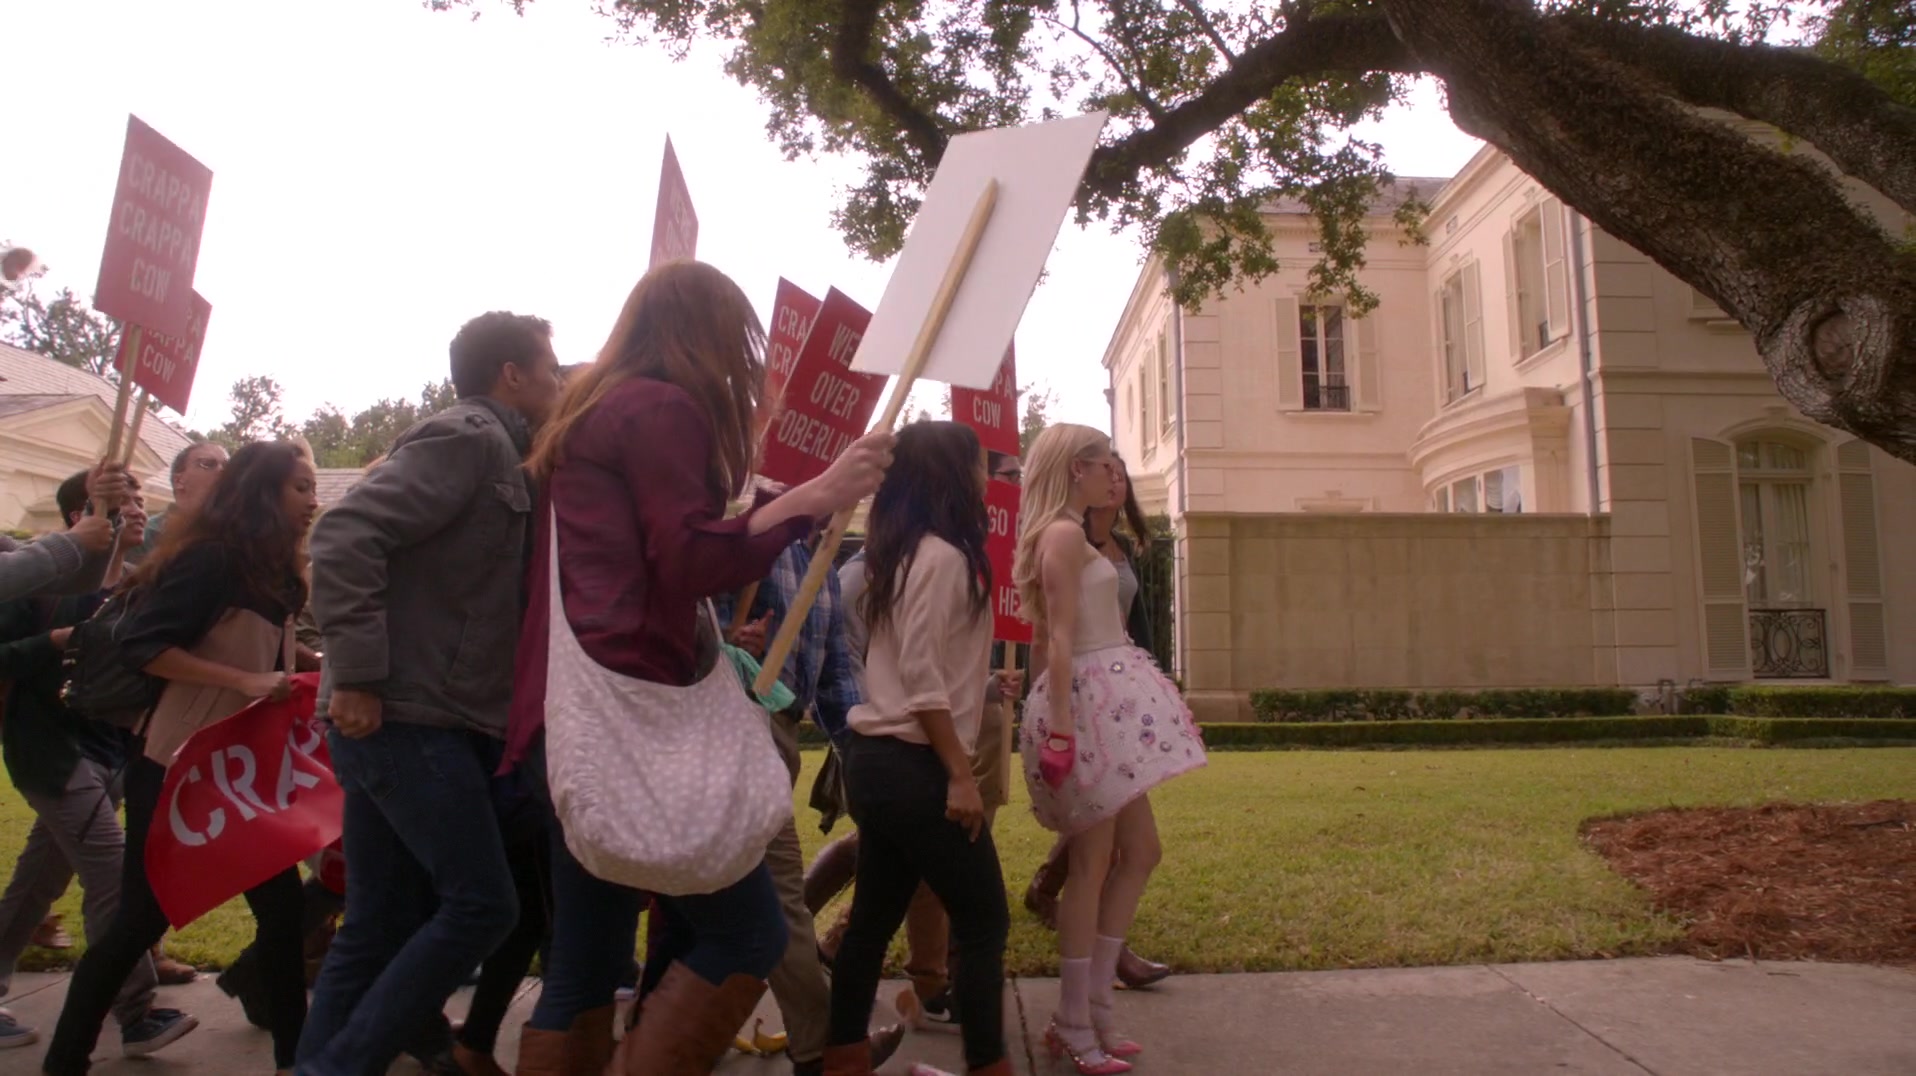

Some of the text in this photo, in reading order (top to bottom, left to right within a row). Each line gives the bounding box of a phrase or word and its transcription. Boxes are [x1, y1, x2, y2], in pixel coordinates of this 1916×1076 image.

[128, 152, 203, 224] CRAPPA
[119, 200, 192, 268] CRAPPA
[130, 257, 171, 304] COW
[778, 305, 813, 341] CRA
[143, 344, 176, 383] COW
[771, 342, 799, 376] CR
[810, 371, 860, 419] OVER
[973, 396, 1001, 429] COW
[987, 505, 1008, 536] GO
